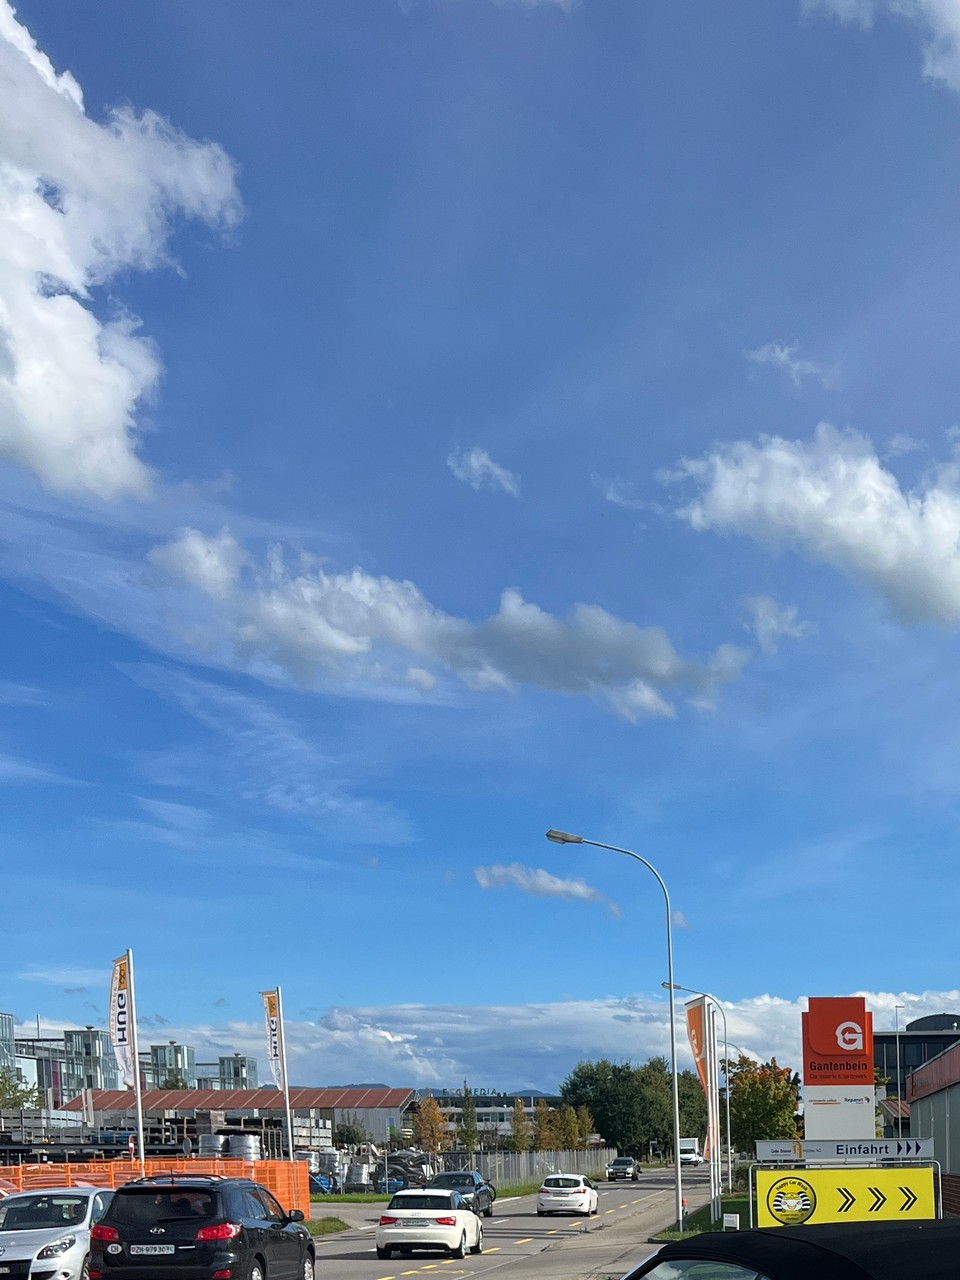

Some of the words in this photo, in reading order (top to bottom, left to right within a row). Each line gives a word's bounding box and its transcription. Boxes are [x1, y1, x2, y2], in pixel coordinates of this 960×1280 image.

[809, 1061, 868, 1071] Gantenbein
[442, 1088, 498, 1096] ECOEDIA
[836, 1144, 889, 1155] Einfahrt
